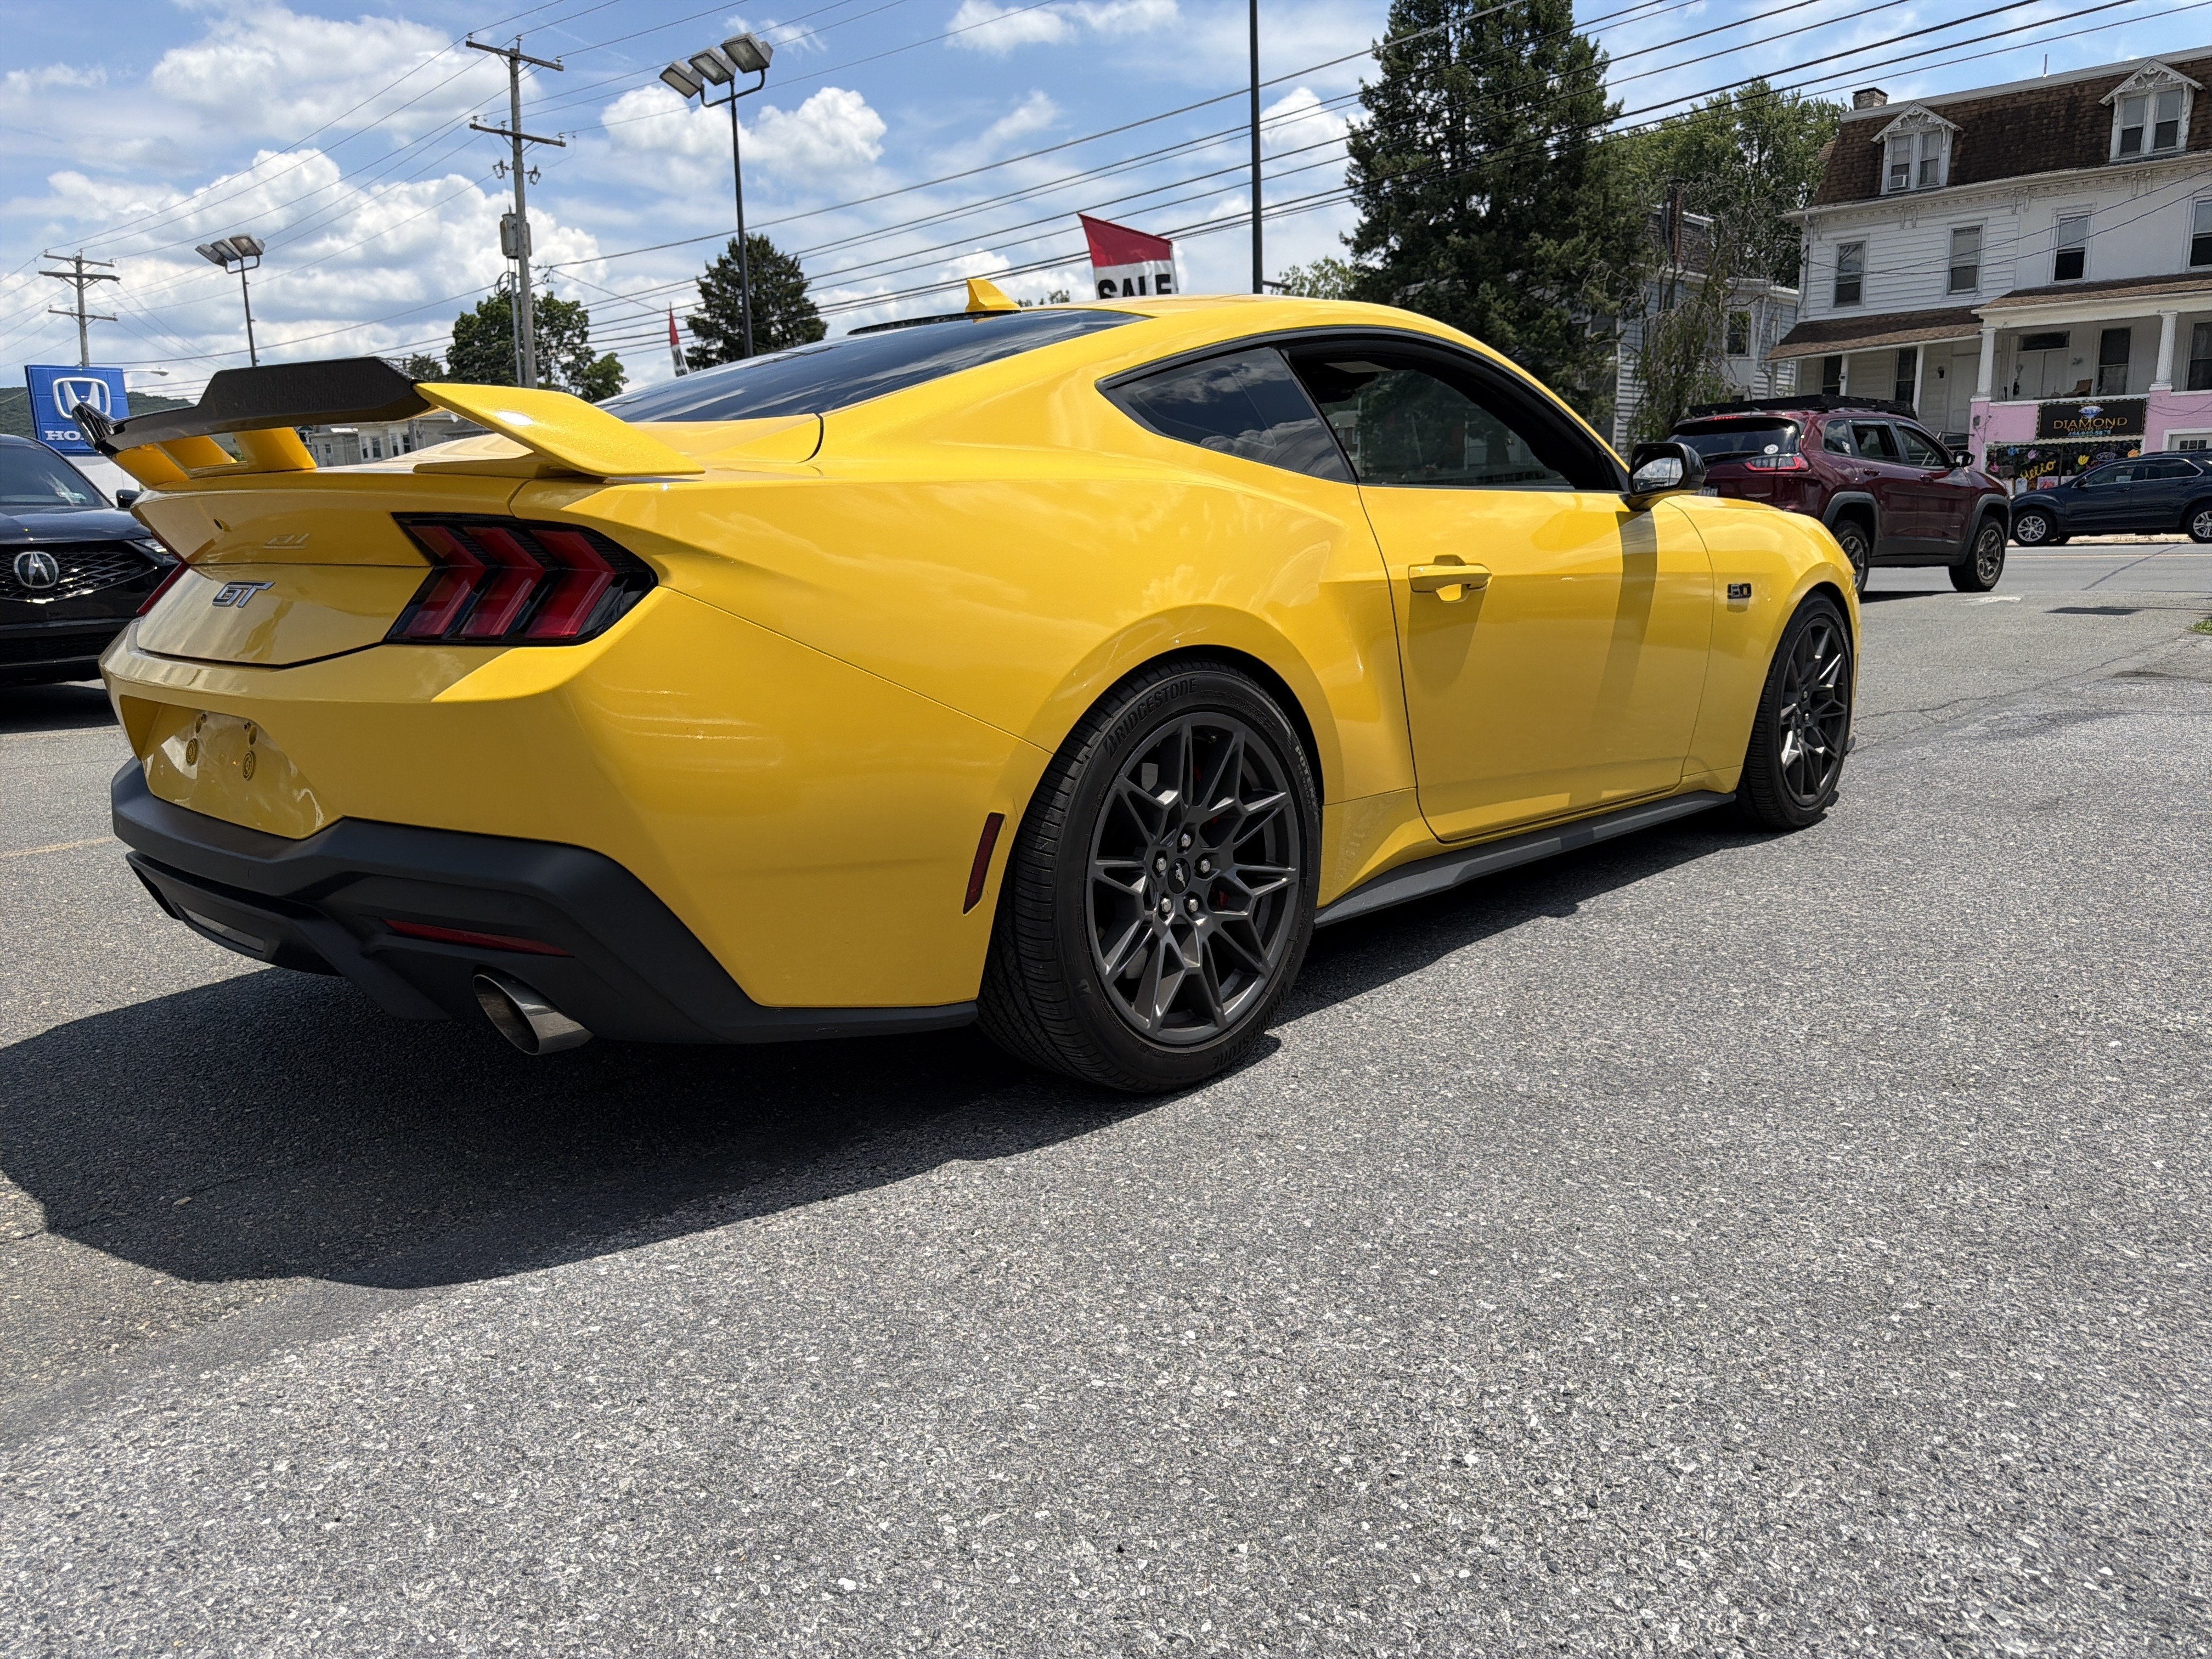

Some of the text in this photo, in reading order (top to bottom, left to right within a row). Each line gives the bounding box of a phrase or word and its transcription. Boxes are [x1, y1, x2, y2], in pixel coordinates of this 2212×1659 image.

[2053, 417, 2128, 429] DIAMOND
[44, 430, 83, 441] HO
[2020, 460, 2056, 480] Hello
[212, 580, 275, 608] GT
[1102, 678, 1198, 759] BRIDGESTONE
